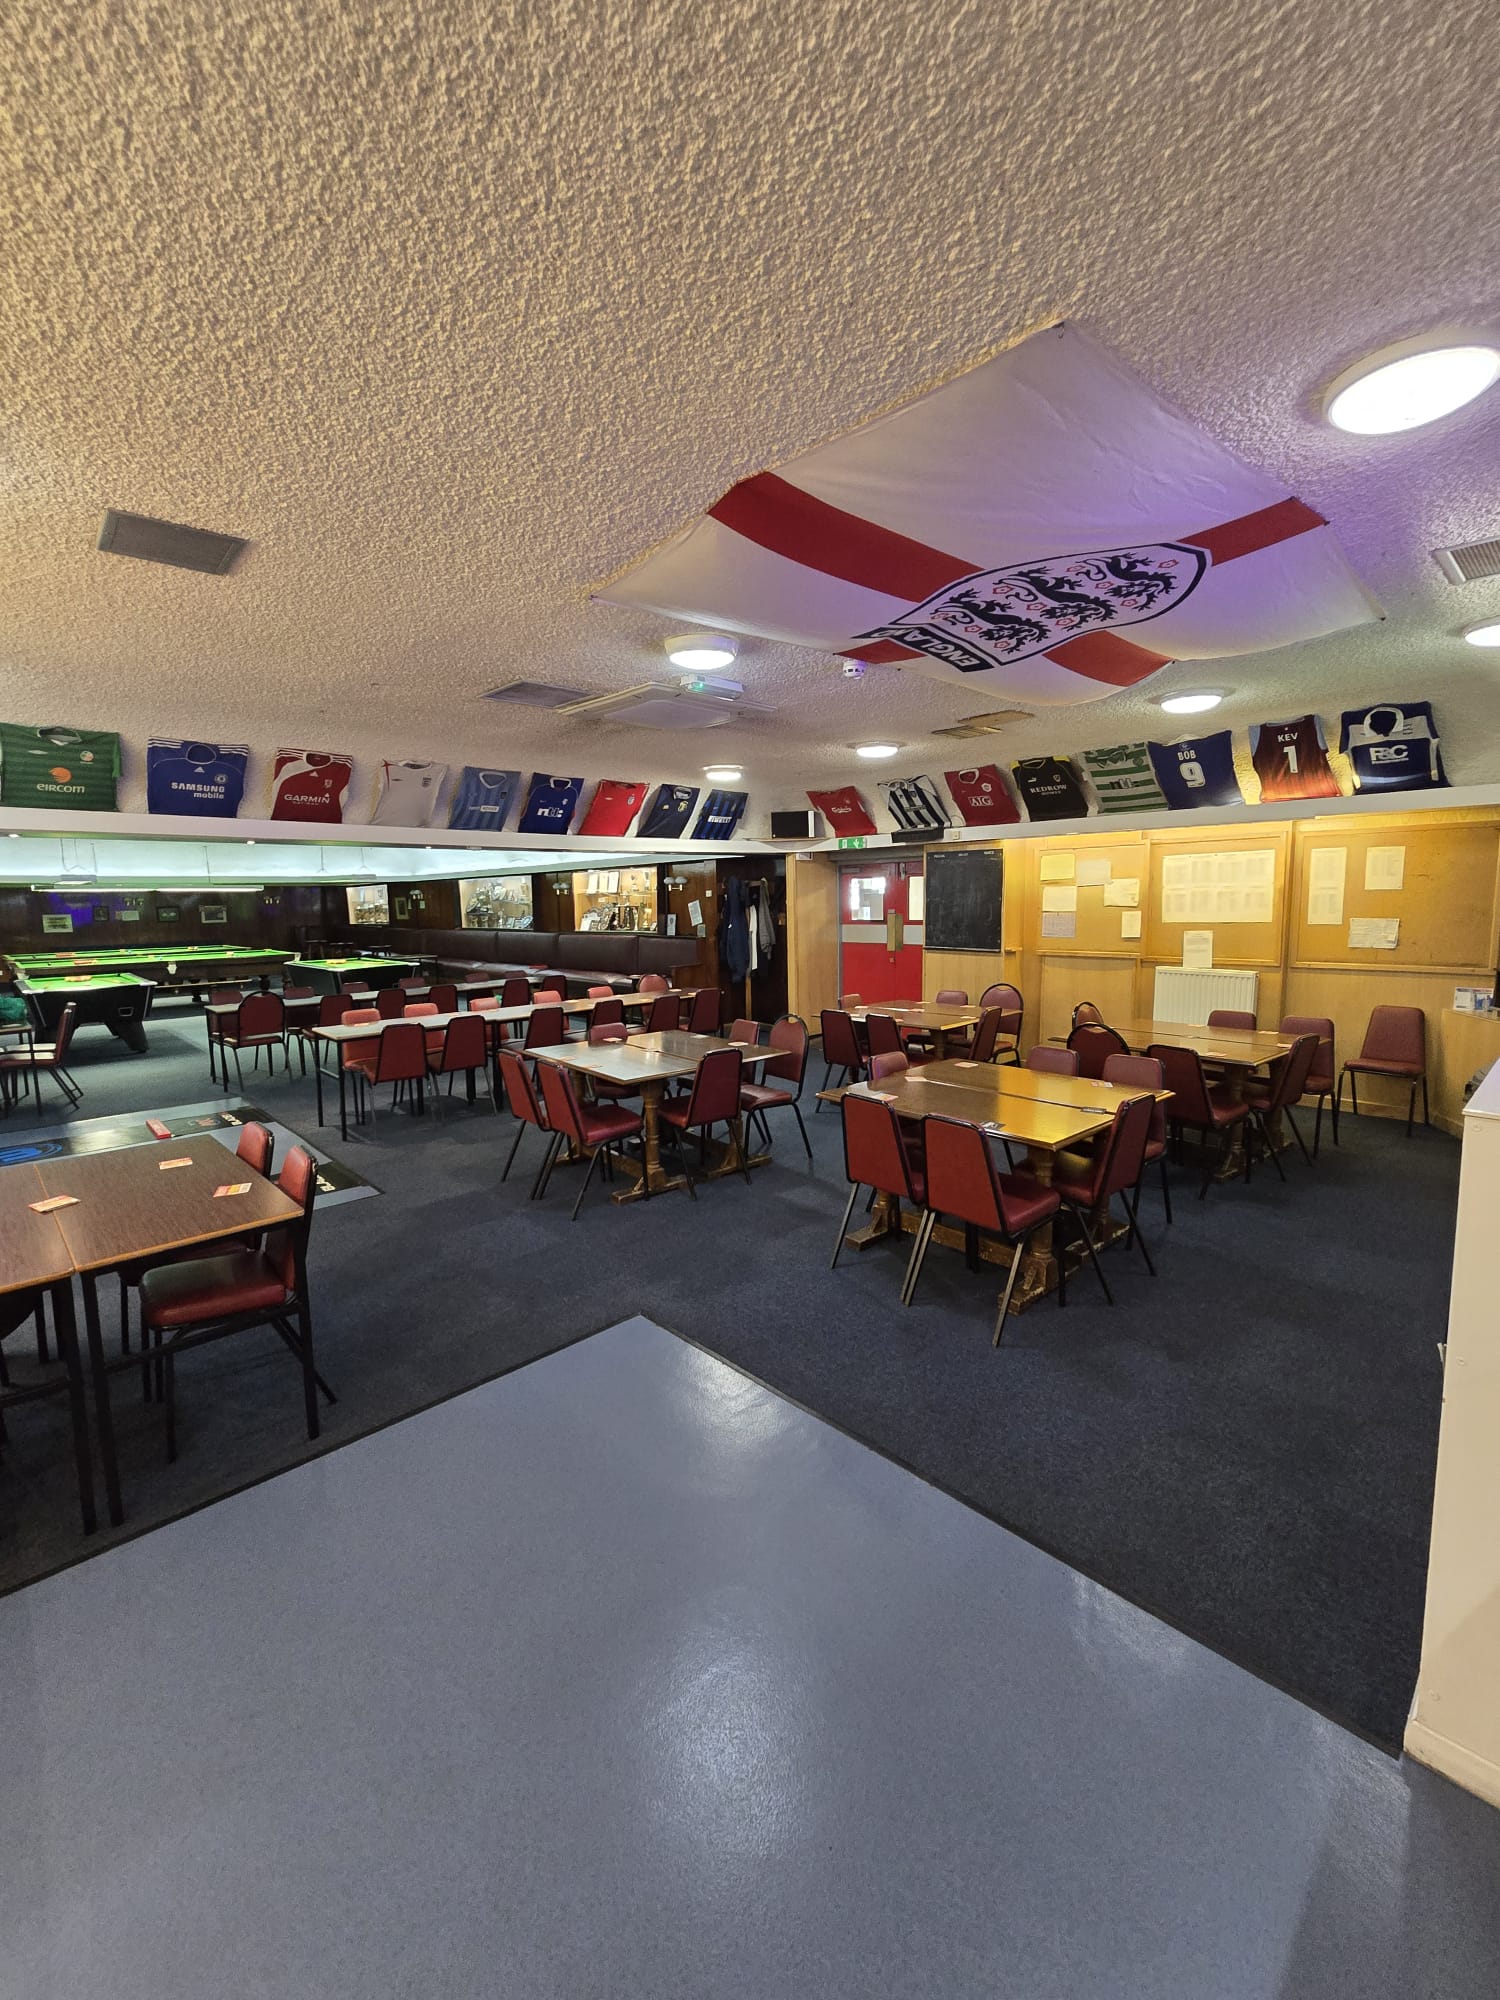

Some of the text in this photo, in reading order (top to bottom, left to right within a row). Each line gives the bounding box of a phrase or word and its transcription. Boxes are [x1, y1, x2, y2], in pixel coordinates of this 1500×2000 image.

[1277, 732, 1298, 743] KEV
[1177, 749, 1197, 761] BOB
[1283, 745, 1299, 774] 1
[1179, 761, 1206, 788] 9
[171, 782, 225, 793] SAMSUNG
[1030, 784, 1067, 794] REDROW
[284, 793, 330, 803] GARMIN
[968, 796, 993, 806] AIG
